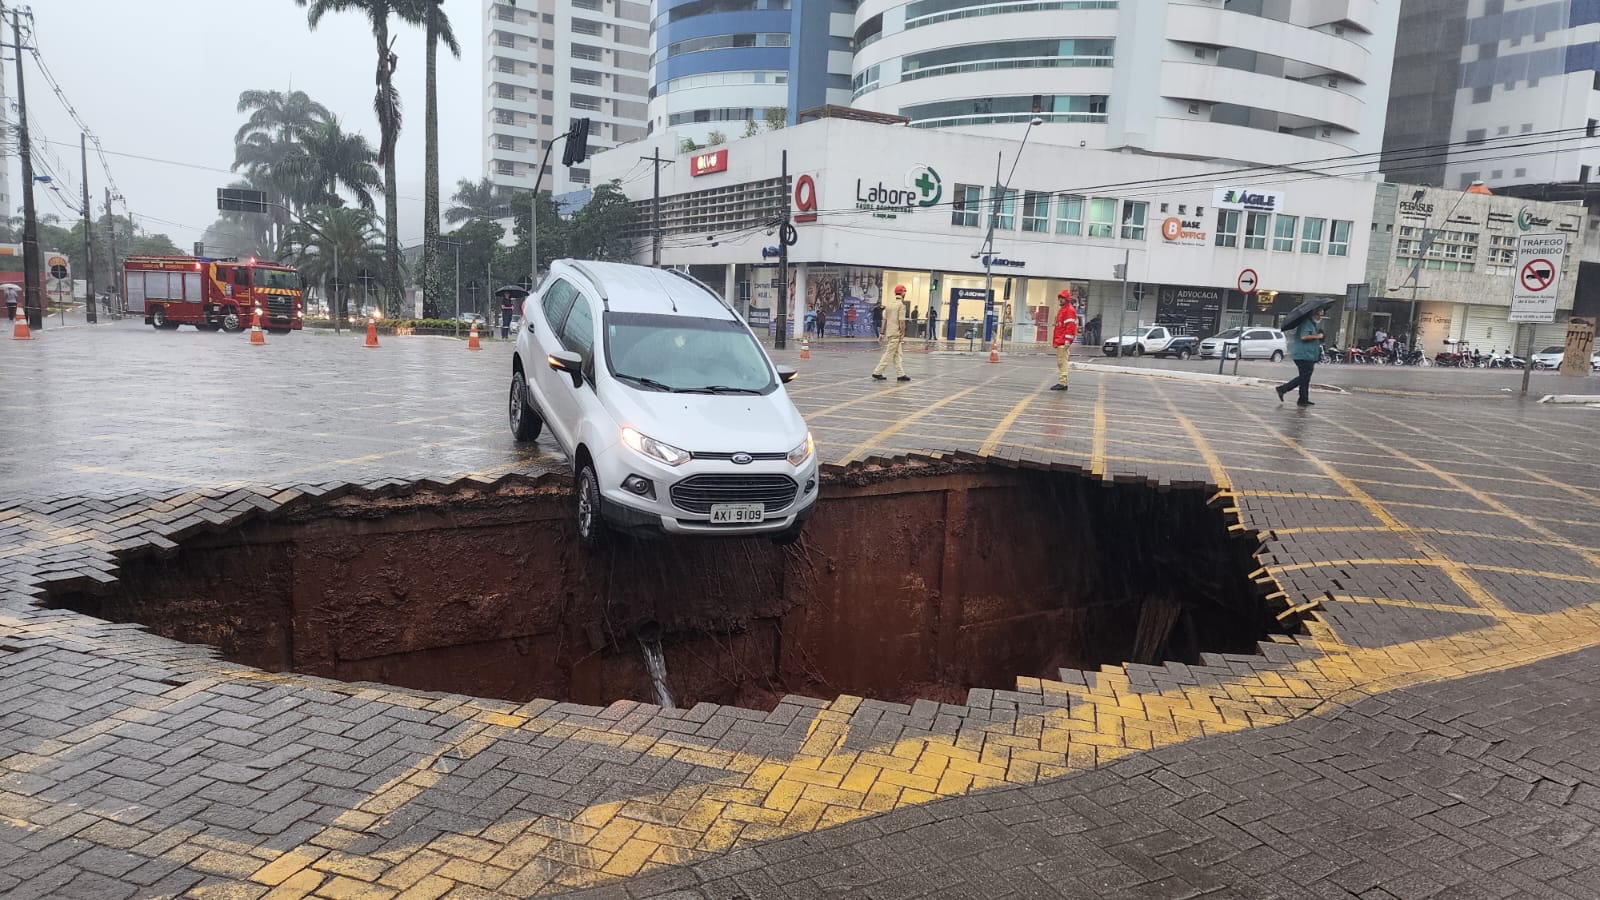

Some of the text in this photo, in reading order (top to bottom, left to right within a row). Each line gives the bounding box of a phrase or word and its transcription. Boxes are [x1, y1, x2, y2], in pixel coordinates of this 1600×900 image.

[856, 178, 916, 206] Labore
[1238, 190, 1276, 207] ÁGILE
[1400, 201, 1434, 213] PEGASUS
[1181, 220, 1201, 229] BASE
[1180, 231, 1206, 240] OFFICE
[1523, 238, 1563, 246] TRÁFEGO
[1520, 247, 1563, 255] PROIBIDO
[1177, 290, 1219, 300] ADVOCACIA
[736, 510, 761, 521] 9109
